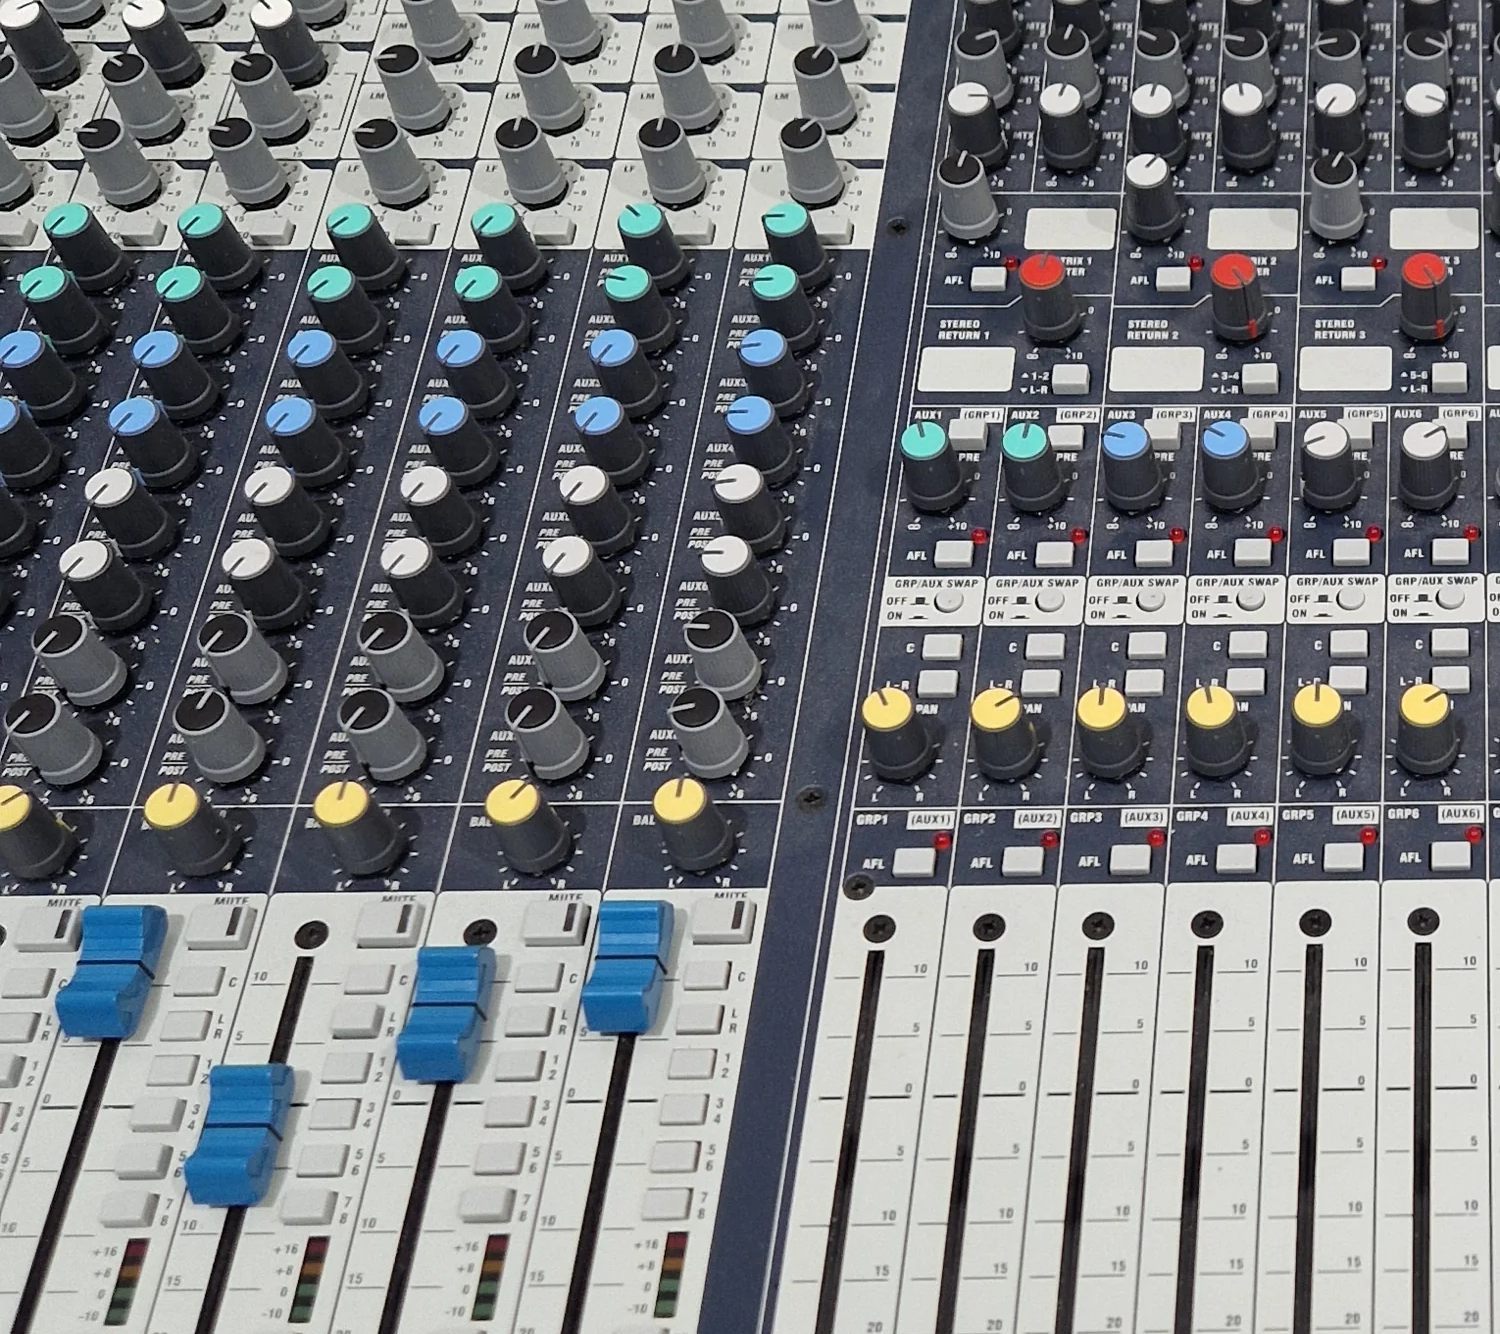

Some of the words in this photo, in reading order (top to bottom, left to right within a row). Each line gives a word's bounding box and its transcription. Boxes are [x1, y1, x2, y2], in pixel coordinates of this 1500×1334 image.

[945, 276, 964, 285] AFL
[939, 319, 980, 329] STEREO
[1128, 319, 1168, 329] STEREO
[1314, 319, 1355, 329] STEREO
[938, 330, 980, 340] RETURN
[984, 330, 989, 340] 1
[1127, 330, 1168, 340] RETURN
[1172, 330, 1179, 340] 2
[1314, 330, 1355, 340] RETURN
[1359, 330, 1366, 340] 3
[1030, 371, 1050, 381] 1-2
[1221, 371, 1239, 381] 3-4
[1030, 385, 1048, 395] L-R
[1221, 385, 1239, 395] L-R
[1410, 384, 1428, 394] L-R
[915, 410, 942, 420] AUX1
[963, 409, 1000, 421] (GRP1)
[1012, 410, 1039, 420] AUX2
[1060, 410, 1097, 421] (GRP2)
[1108, 410, 1135, 420] AUX3
[1156, 409, 1193, 421] (GRP3)
[1204, 410, 1231, 420] AUX4
[1252, 409, 1289, 421] (GRP4)
[1299, 409, 1327, 420] AUX5
[1347, 408, 1384, 420] (GRP5)
[1395, 408, 1422, 419] AUX6
[1442, 408, 1479, 420] (GRP6)
[906, 551, 927, 561] AFL
[895, 579, 944, 589] GRP/AUX
[947, 578, 979, 588] SWAP
[1096, 578, 1145, 588] GRP/AUX
[1148, 577, 1179, 587] SWAP
[886, 597, 908, 606] OFF
[887, 611, 902, 620] ON
[646, 747, 668, 757] PRE
[644, 761, 673, 771] POST
[964, 813, 995, 825] GRP2
[1018, 812, 1057, 825] (AUX2)
[1070, 812, 1102, 824] GRP3
[1125, 811, 1164, 823] (AUX3)
[1177, 811, 1208, 822] GRP4
[1231, 810, 1270, 822] (AUX4)
[1283, 810, 1314, 821] GRP5
[1336, 808, 1375, 821] (AUX5)
[1388, 808, 1420, 820] GRP6
[1441, 808, 1480, 820] (AUX6)
[633, 815, 656, 826] BAL
[856, 814, 888, 826] GRP1
[911, 813, 951, 826] (AUX1)
[863, 858, 885, 869] AFL
